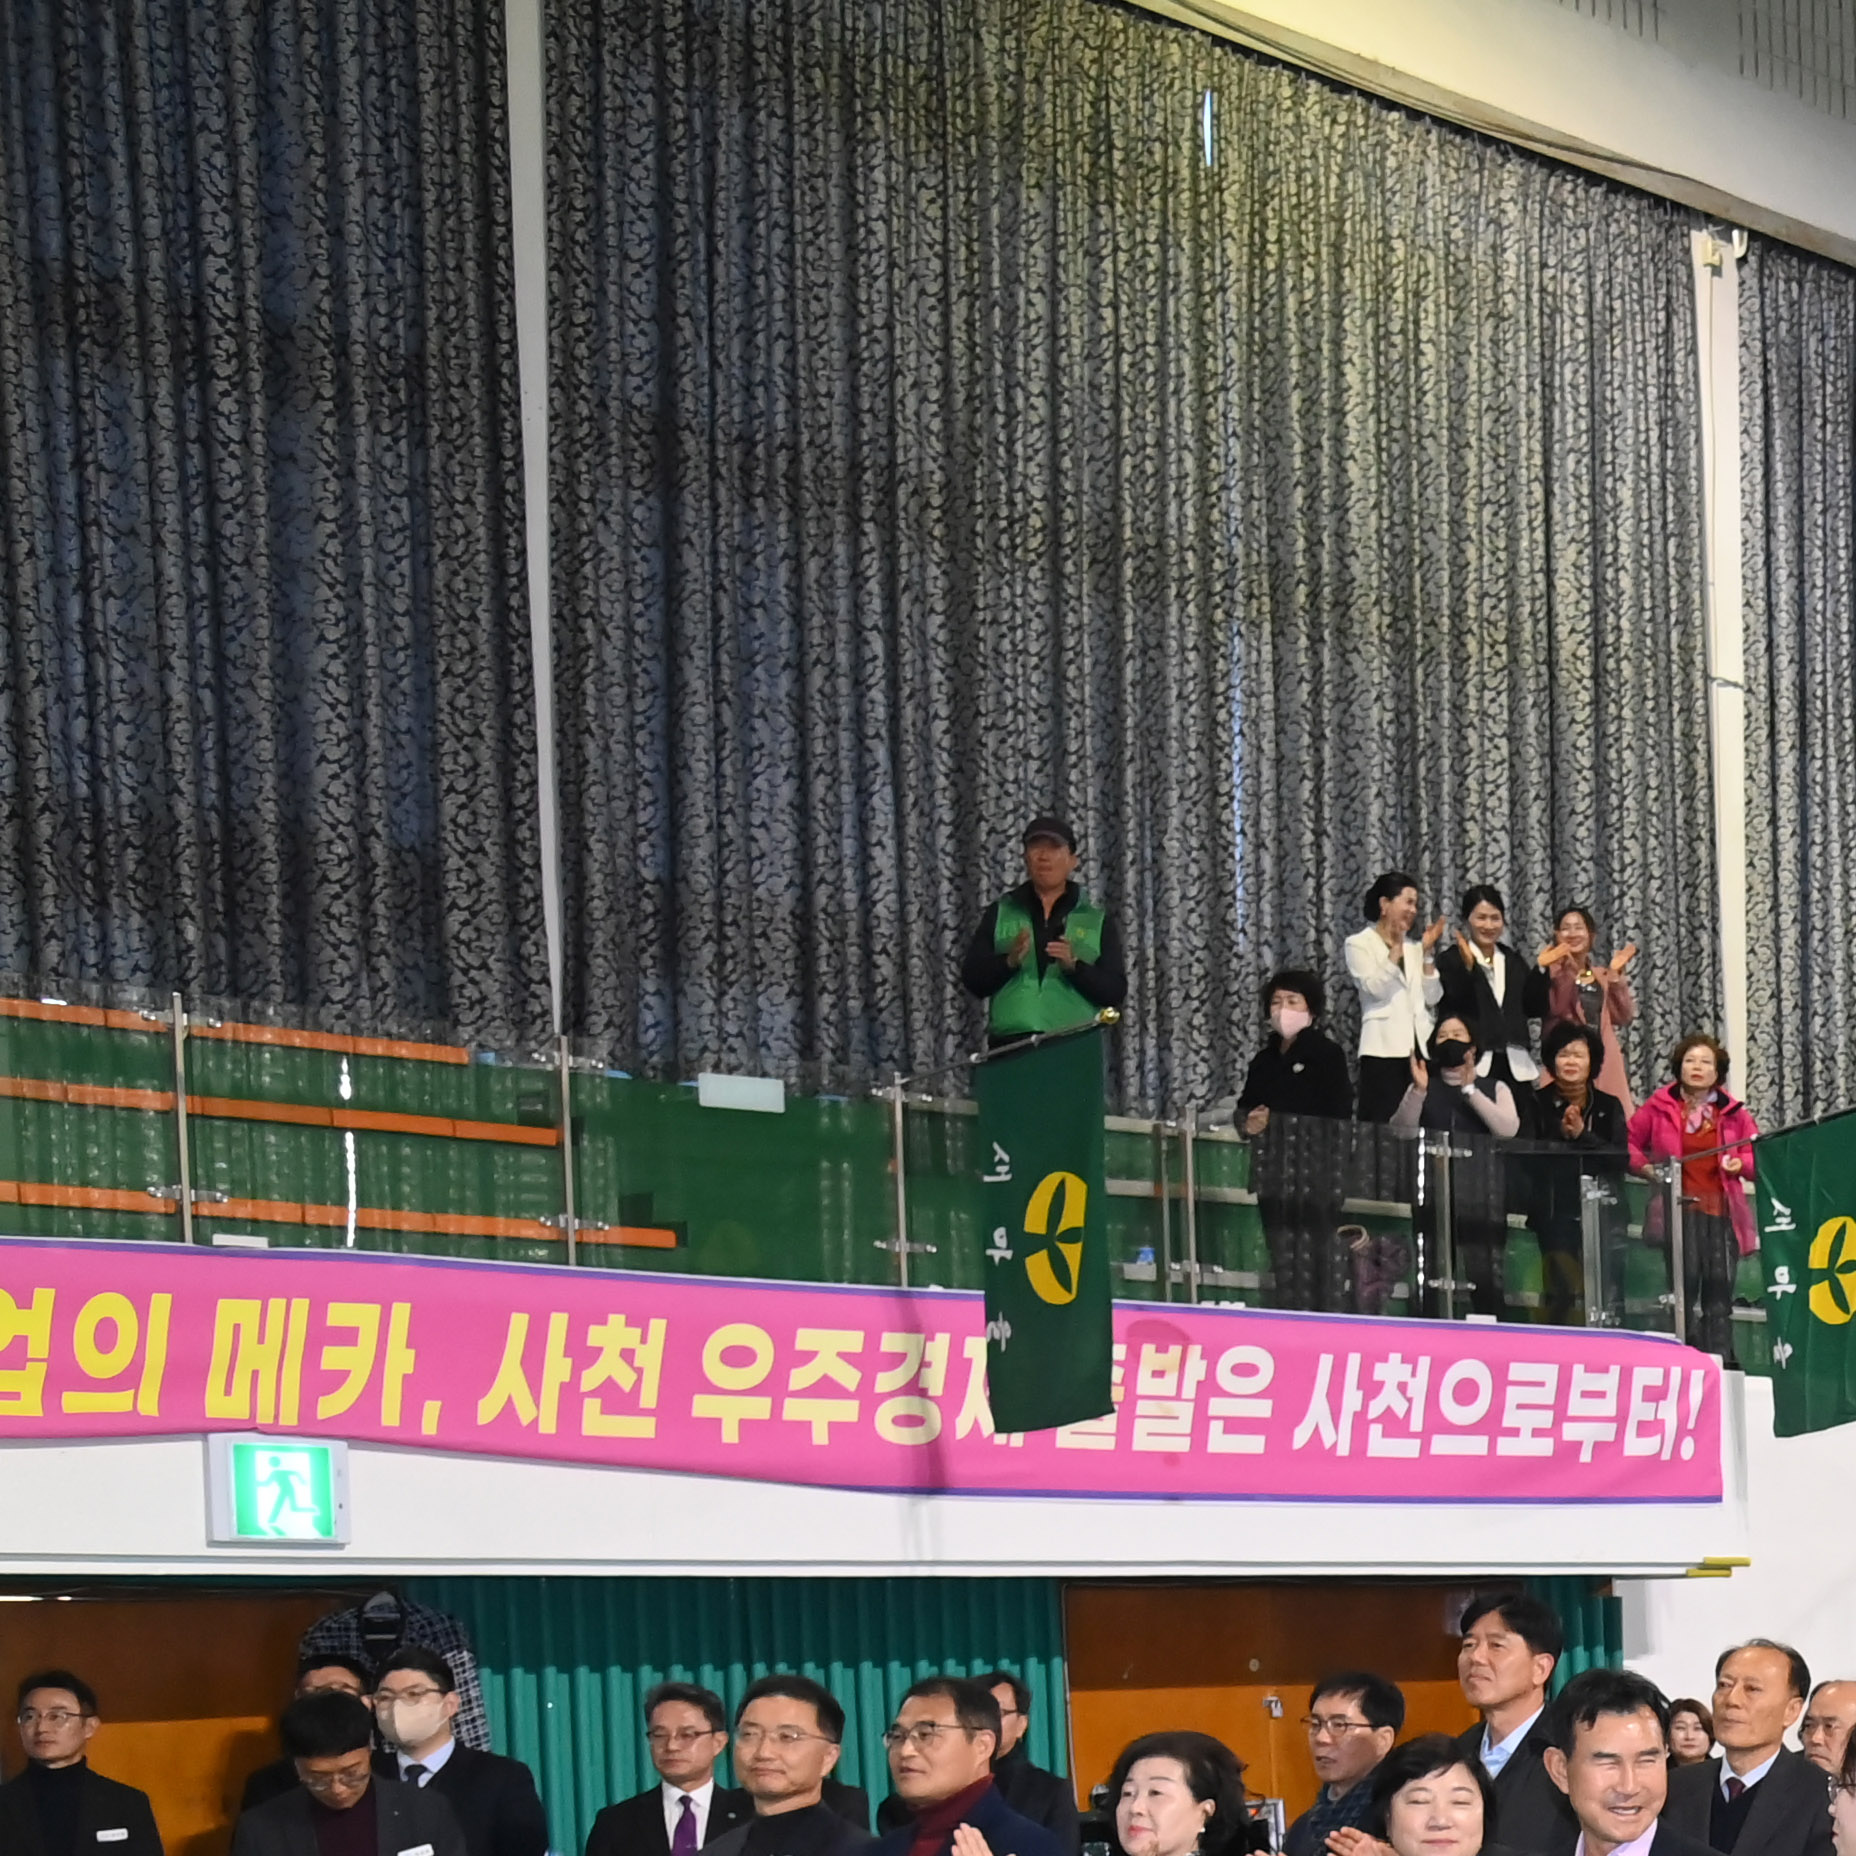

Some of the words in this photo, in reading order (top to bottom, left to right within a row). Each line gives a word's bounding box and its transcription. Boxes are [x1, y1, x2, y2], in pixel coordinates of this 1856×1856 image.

[204, 1297, 443, 1436] 메카,
[477, 1311, 668, 1440] 사천
[1292, 1351, 1706, 1463] 사천으로부터!
